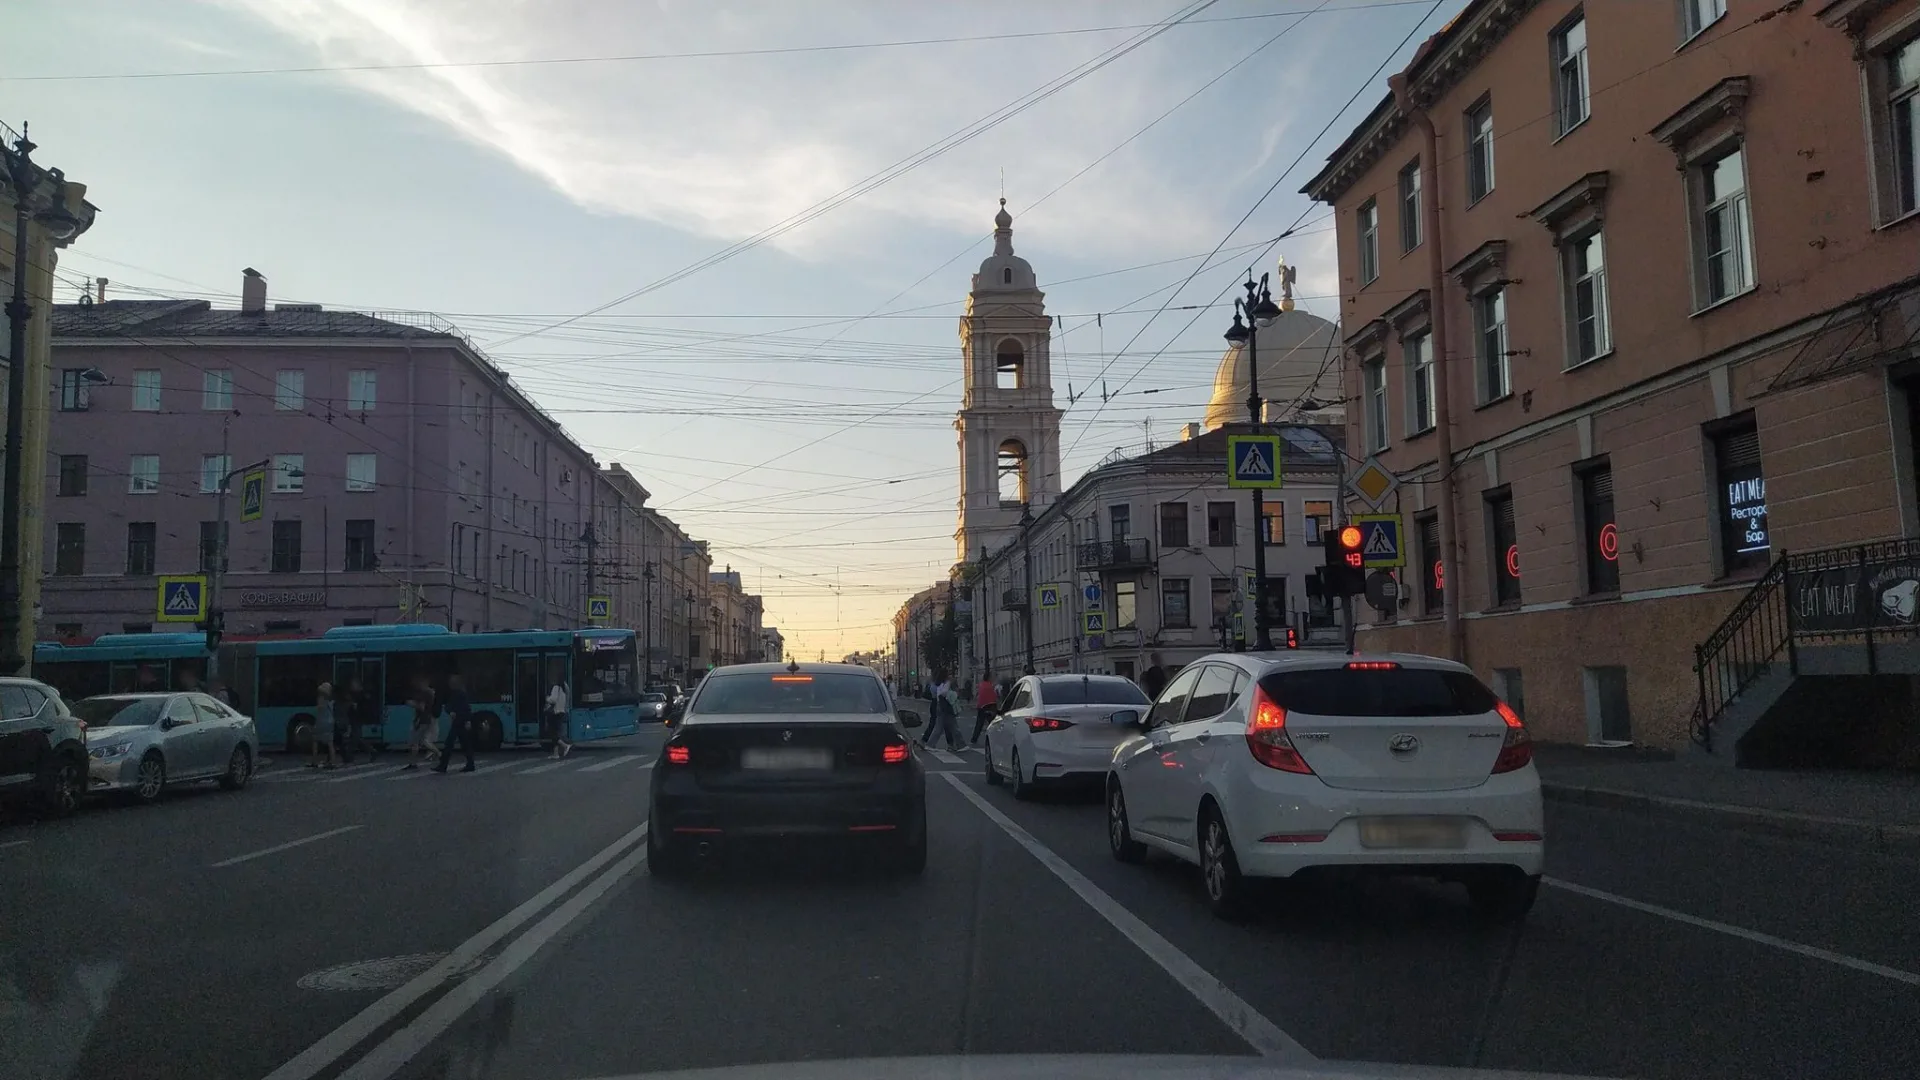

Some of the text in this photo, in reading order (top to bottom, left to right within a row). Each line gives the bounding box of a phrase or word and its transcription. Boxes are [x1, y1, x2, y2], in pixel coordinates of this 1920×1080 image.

[1729, 480, 1747, 505] EAT
[1750, 517, 1758, 530] &
[1746, 531, 1764, 543] Бар
[1346, 552, 1362, 567] 43
[1800, 582, 1856, 617] EAT MEAT
